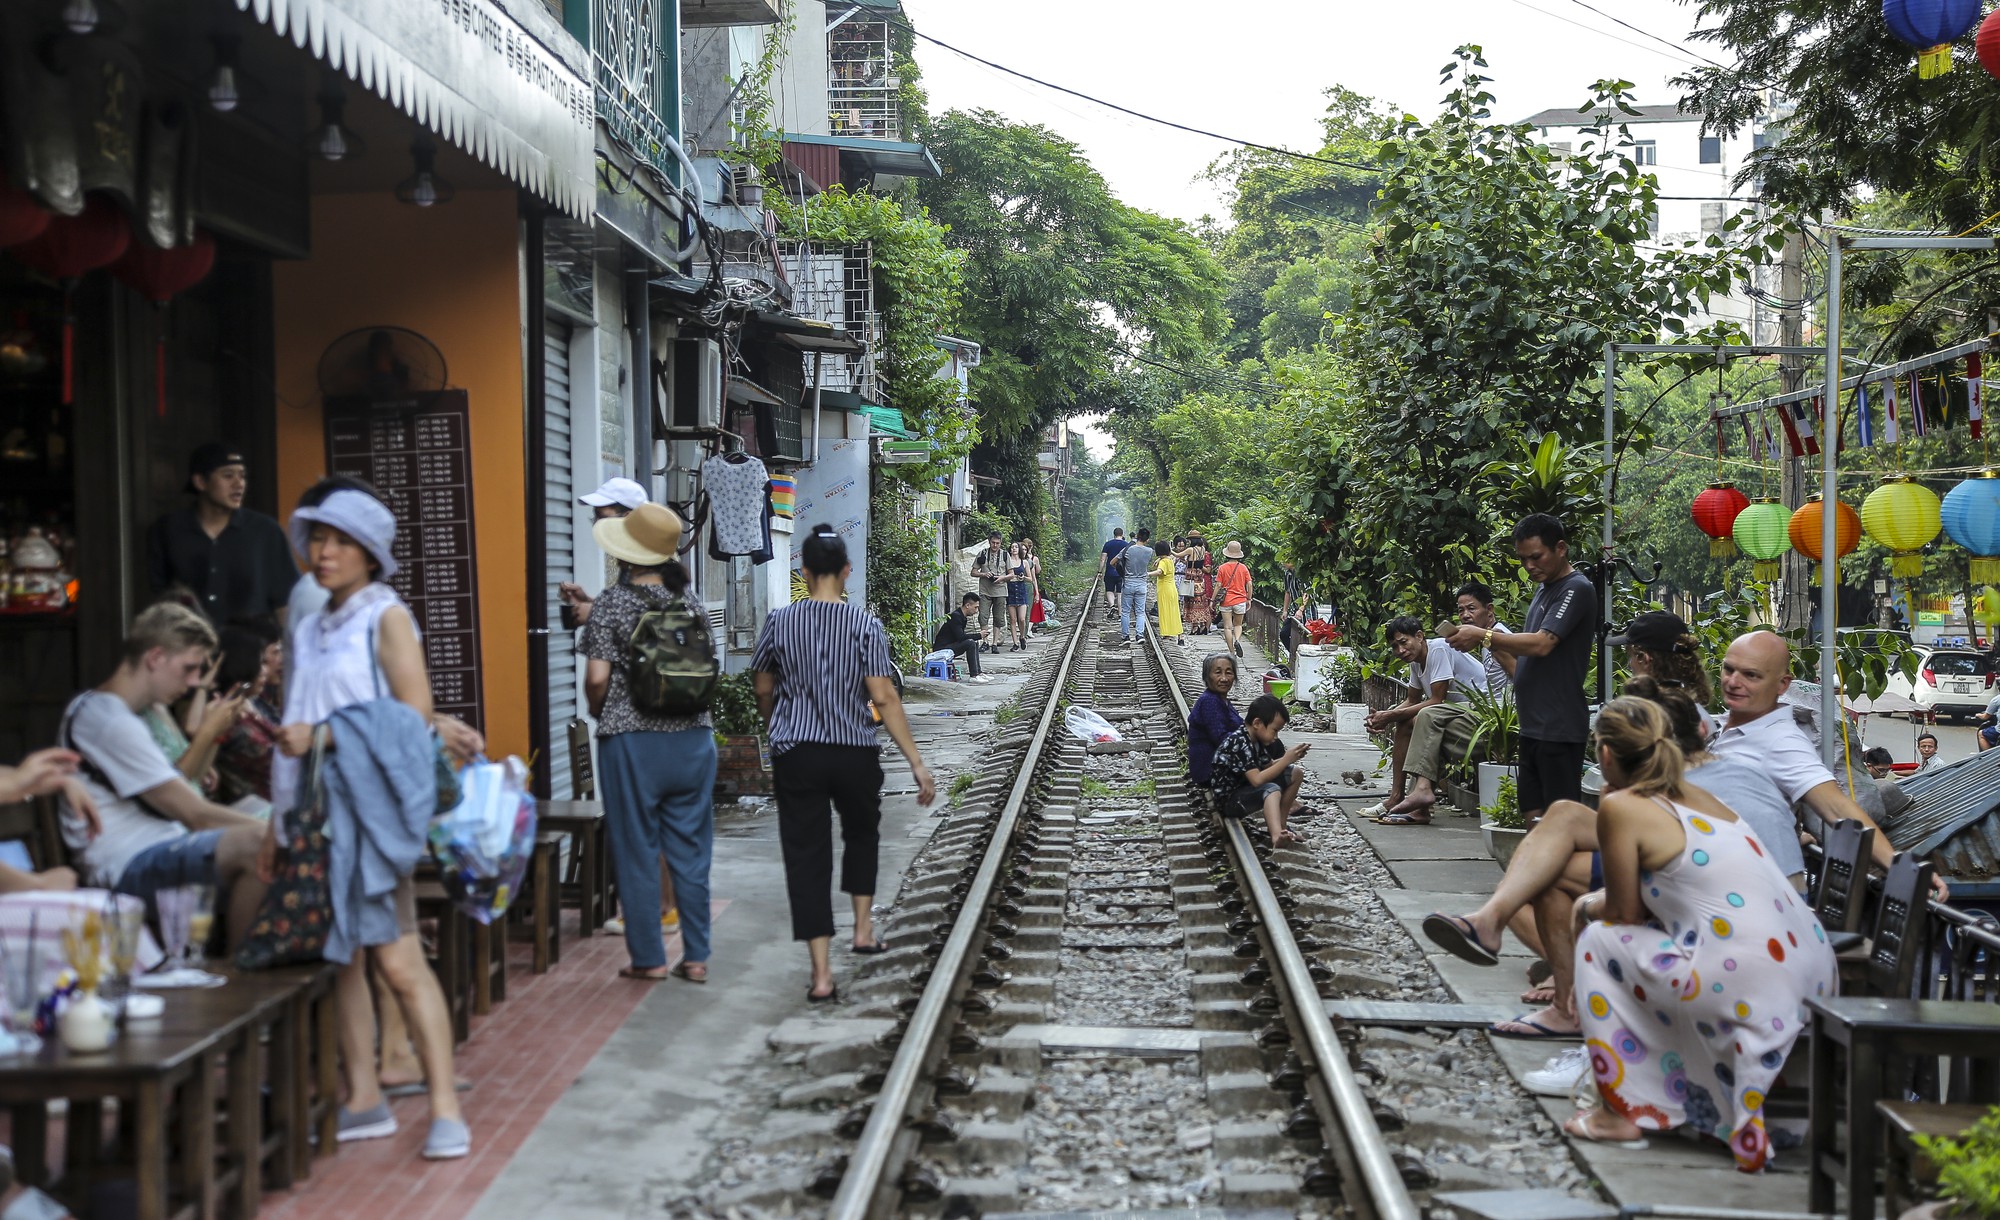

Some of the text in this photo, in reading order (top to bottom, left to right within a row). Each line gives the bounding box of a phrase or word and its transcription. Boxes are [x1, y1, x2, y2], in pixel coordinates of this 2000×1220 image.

[472, 4, 502, 55] COFFEE
[532, 54, 568, 109] FAST FOOD
[824, 480, 855, 499] ALUTITAN
